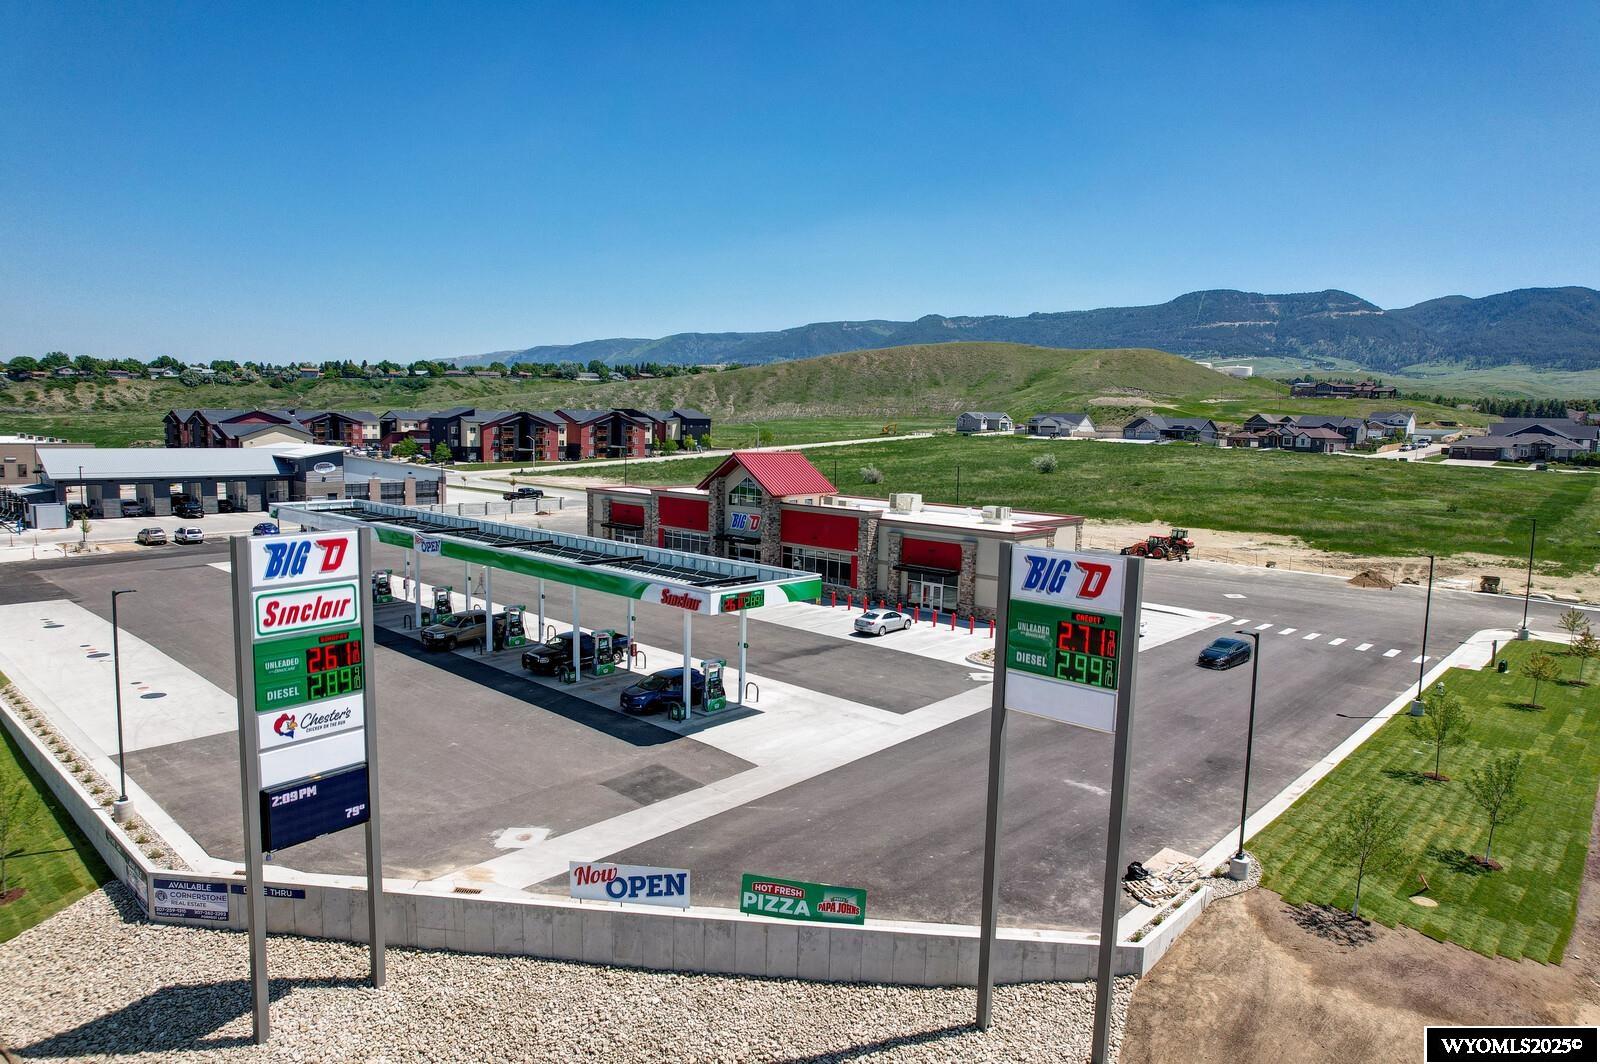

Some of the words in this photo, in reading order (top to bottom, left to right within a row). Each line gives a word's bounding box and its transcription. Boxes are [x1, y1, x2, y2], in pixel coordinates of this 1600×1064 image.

[731, 513, 748, 531] BIG
[749, 515, 761, 532] D
[263, 540, 311, 580] BIG
[314, 537, 349, 574] D
[1021, 555, 1072, 595] BIG
[1074, 561, 1112, 599] D
[661, 588, 702, 611] Sinclair
[263, 596, 351, 628] Sinclair
[1075, 613, 1101, 624] CREDIT
[1017, 621, 1050, 636] UNLEADED
[264, 657, 299, 670] UNLEADED
[1016, 651, 1048, 668] DIESEL
[1057, 651, 1103, 687] 2.99
[267, 686, 299, 701] DIESEL
[311, 668, 352, 699] 2.89
[300, 707, 352, 729] Chester's
[271, 791, 298, 807] 2:09
[299, 784, 317, 799] PM
[574, 865, 617, 886] Now
[606, 873, 687, 898] OPEN
[168, 881, 212, 891] AVAILABLE
[270, 888, 293, 897] THRU
[755, 884, 773, 892] HOT
[774, 886, 803, 897] FRESH
[169, 891, 227, 902] CORNERSTONE
[742, 891, 811, 917] PIZZA
[818, 902, 836, 912] PAPA
